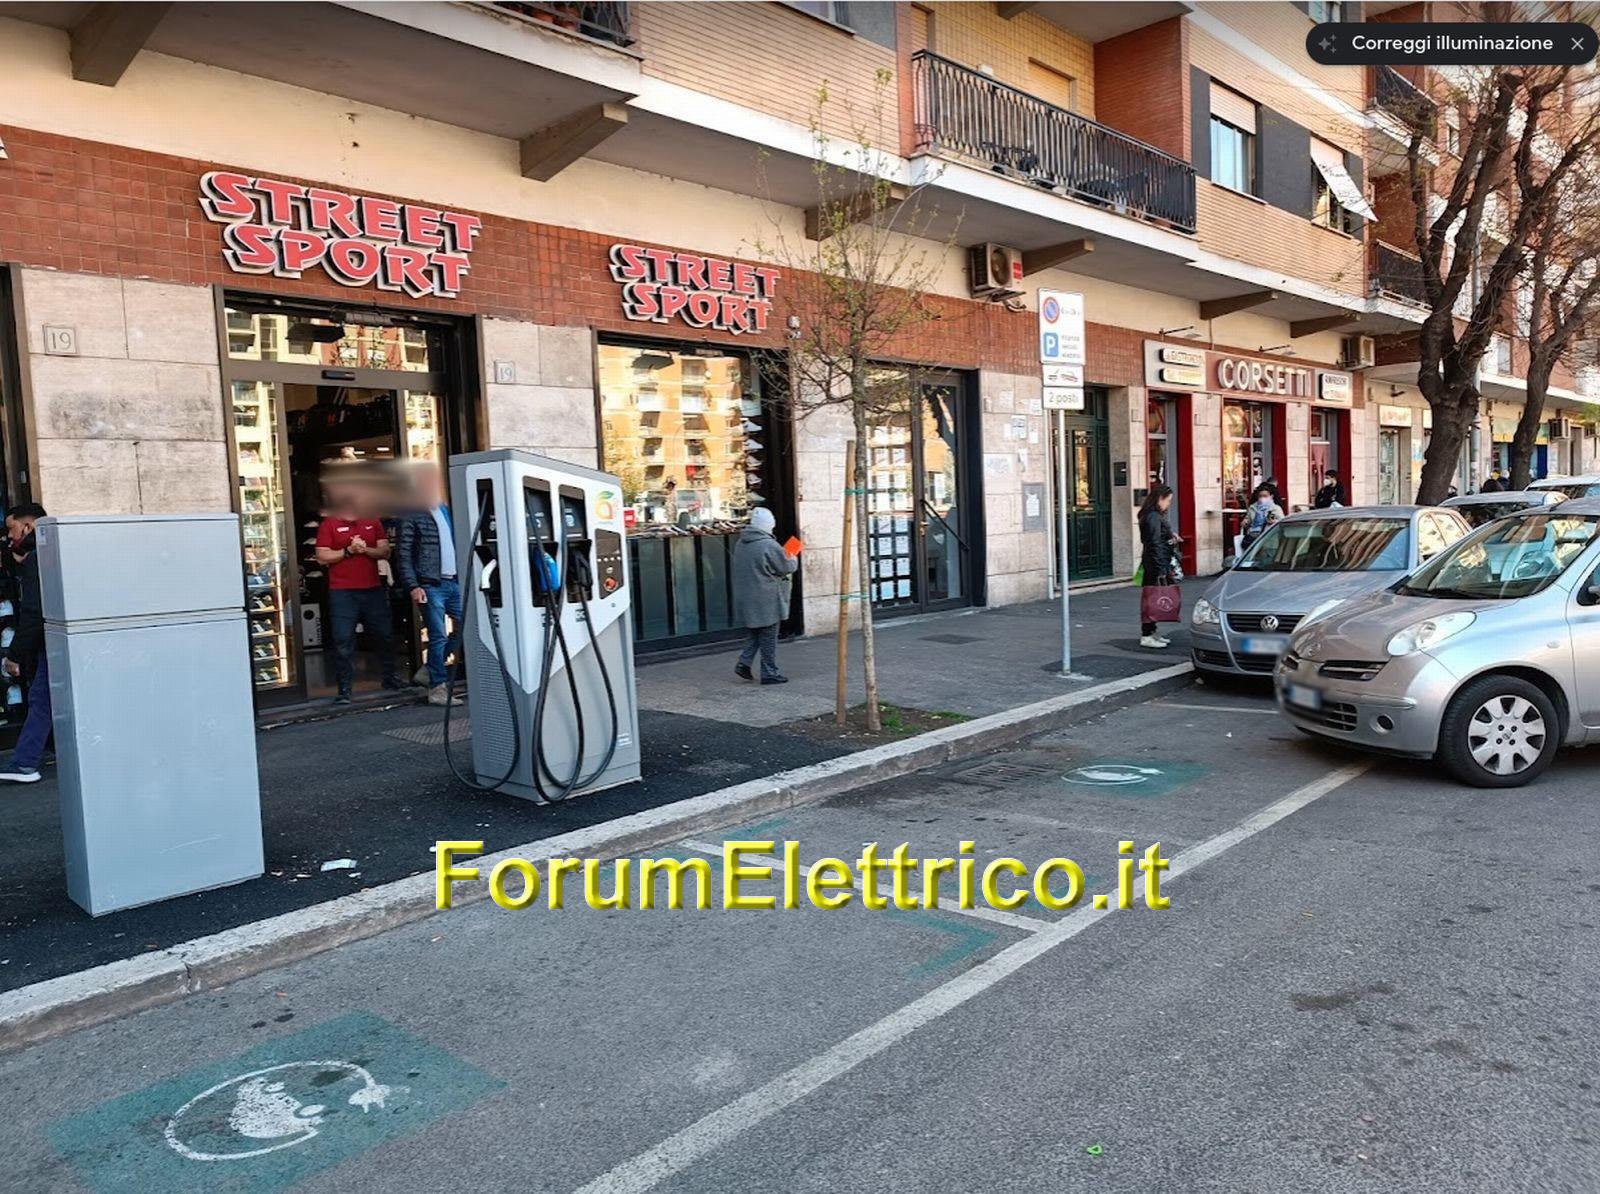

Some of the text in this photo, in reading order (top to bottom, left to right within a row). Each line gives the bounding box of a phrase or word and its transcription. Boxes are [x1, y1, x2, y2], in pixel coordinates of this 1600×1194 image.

[200, 171, 482, 252] STREET
[222, 222, 471, 298] SPORT
[609, 244, 781, 298] STREET
[623, 283, 773, 335] SPORT
[51, 331, 72, 350] 19
[1048, 392, 1055, 403] 2
[1218, 358, 1312, 398] CORSETTI
